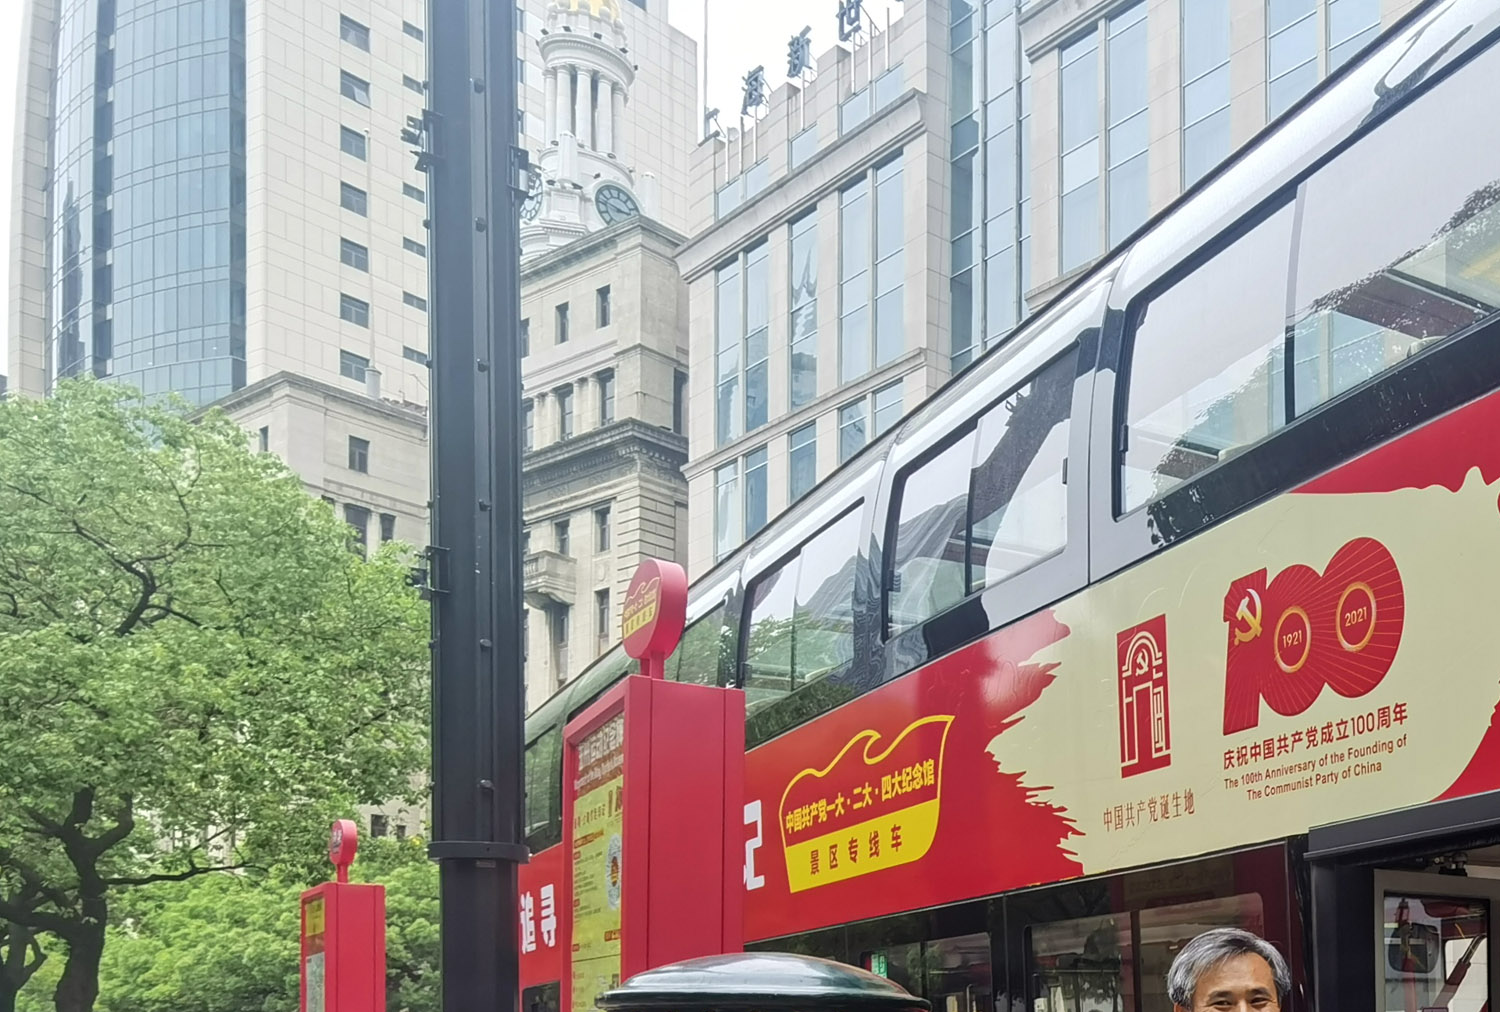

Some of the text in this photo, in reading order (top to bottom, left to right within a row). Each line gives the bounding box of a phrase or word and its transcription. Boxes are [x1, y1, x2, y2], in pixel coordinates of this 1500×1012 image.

[1282, 629, 1303, 649] 1921
[1344, 606, 1368, 628] 2021
[1223, 702, 1409, 771] 庆祝中国共产党成立100周年
[1224, 732, 1409, 790] The 100th Anniversary of the Founding of
[1247, 761, 1383, 801] The Communist Party of China
[1102, 787, 1196, 833] 中国共产党诞生地
[810, 823, 903, 876] 景区专线车
